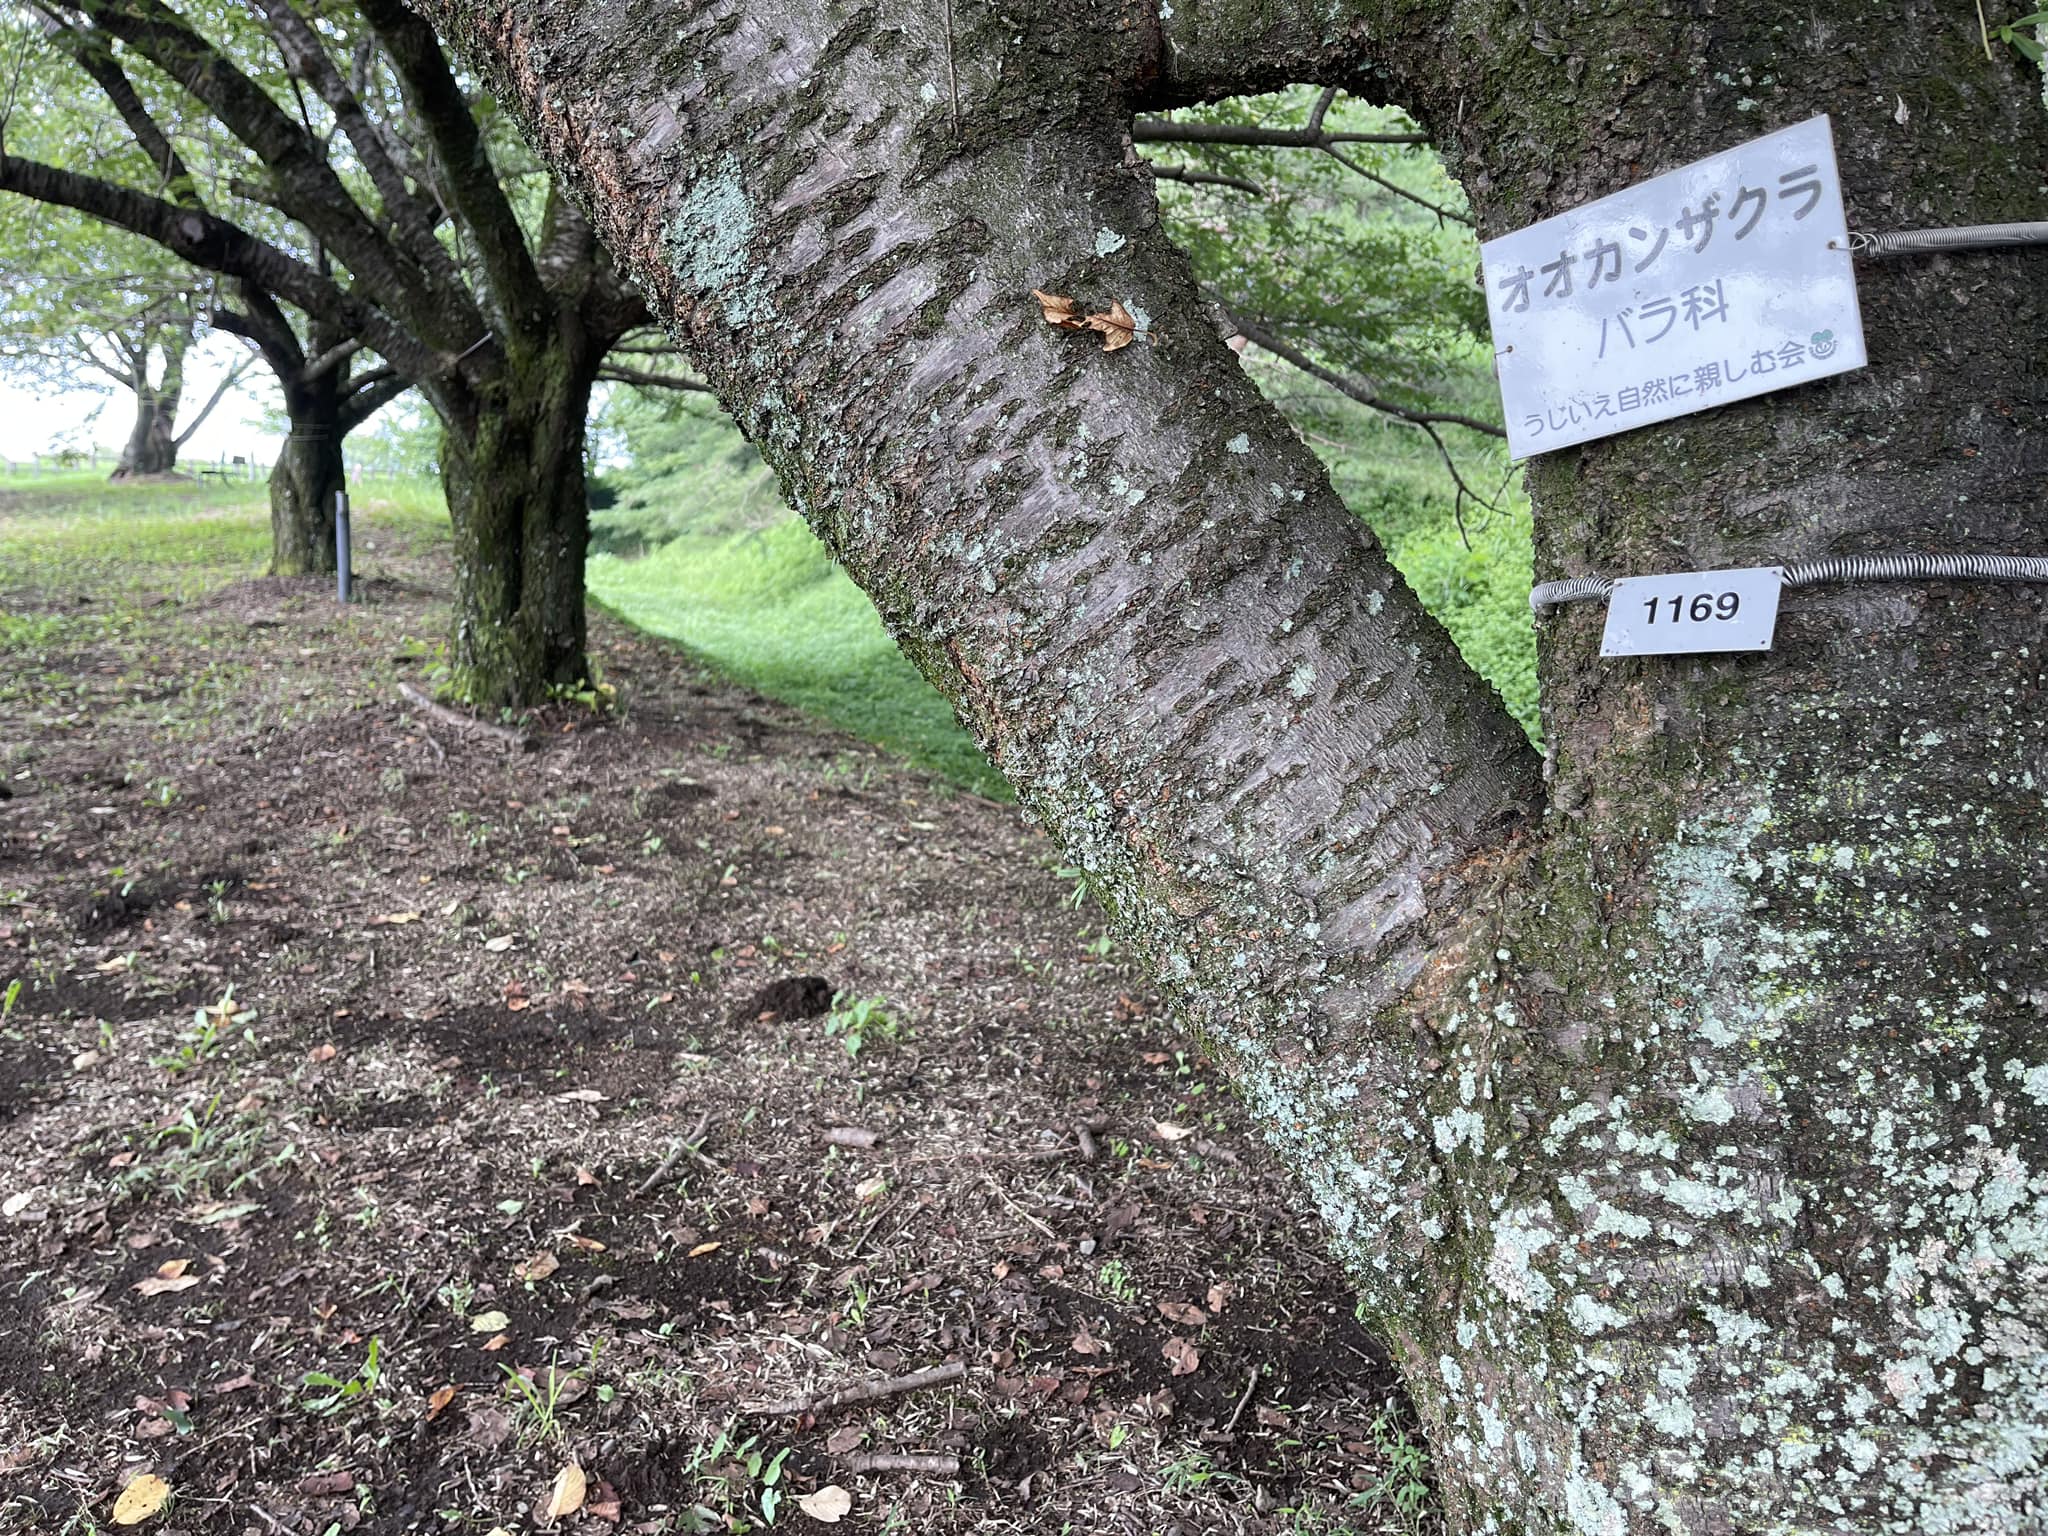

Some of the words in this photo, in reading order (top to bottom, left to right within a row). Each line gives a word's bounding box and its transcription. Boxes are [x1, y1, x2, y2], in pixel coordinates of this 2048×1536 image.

[1498, 164, 1822, 313] オオカンザクラ
[1598, 279, 1729, 358] バラ科
[1524, 340, 1806, 437] うじいえ自然に親しむ会
[1643, 591, 1740, 625] 1169
